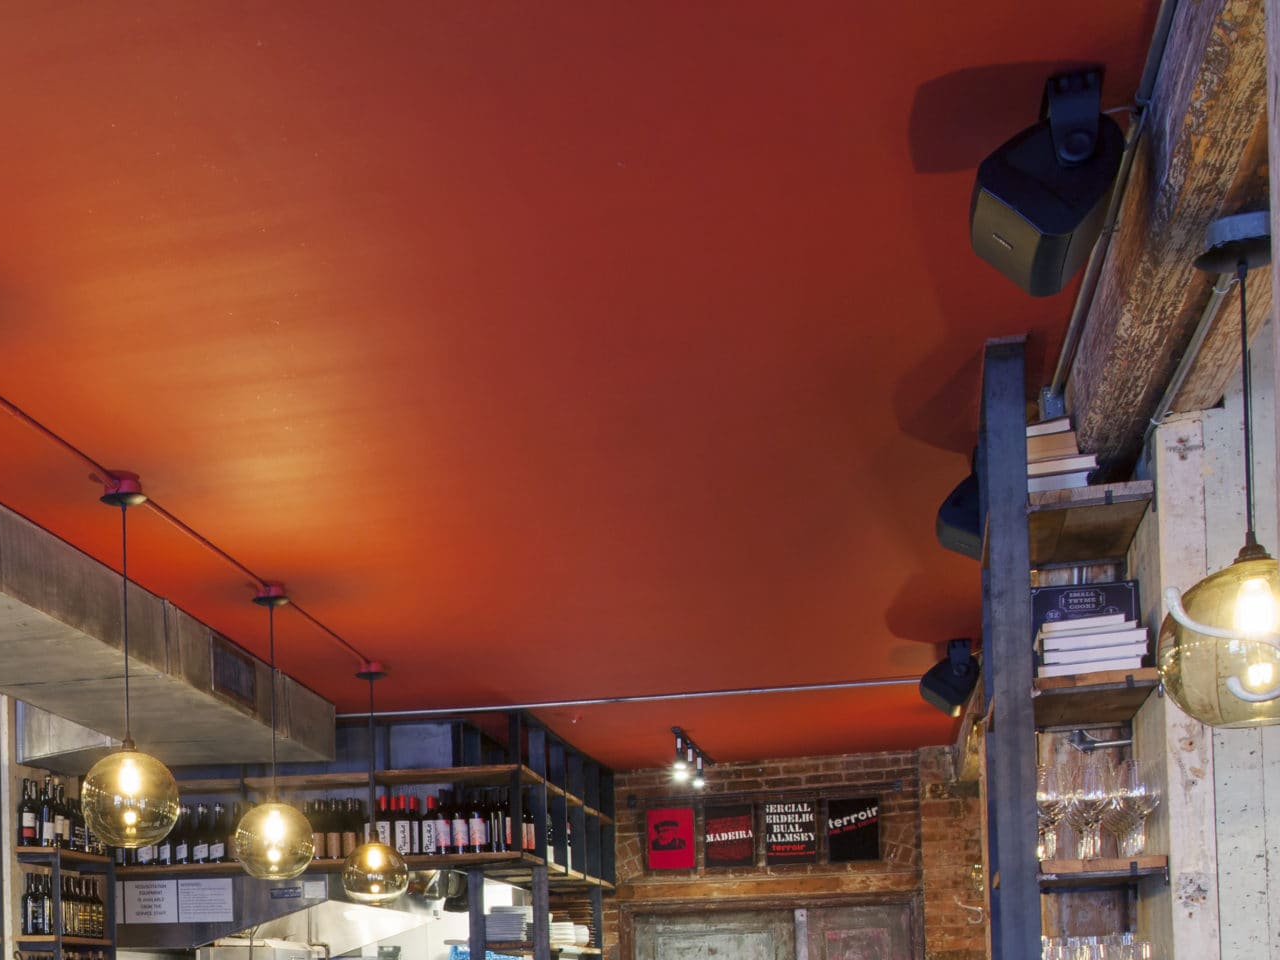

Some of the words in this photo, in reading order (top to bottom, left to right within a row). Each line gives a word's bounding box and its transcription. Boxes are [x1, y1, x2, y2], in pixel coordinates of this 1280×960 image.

[828, 806, 879, 829] terroir
[772, 824, 803, 832] BUAL
[705, 830, 753, 842] MADEIRA
[766, 832, 815, 842] ALMSEY
